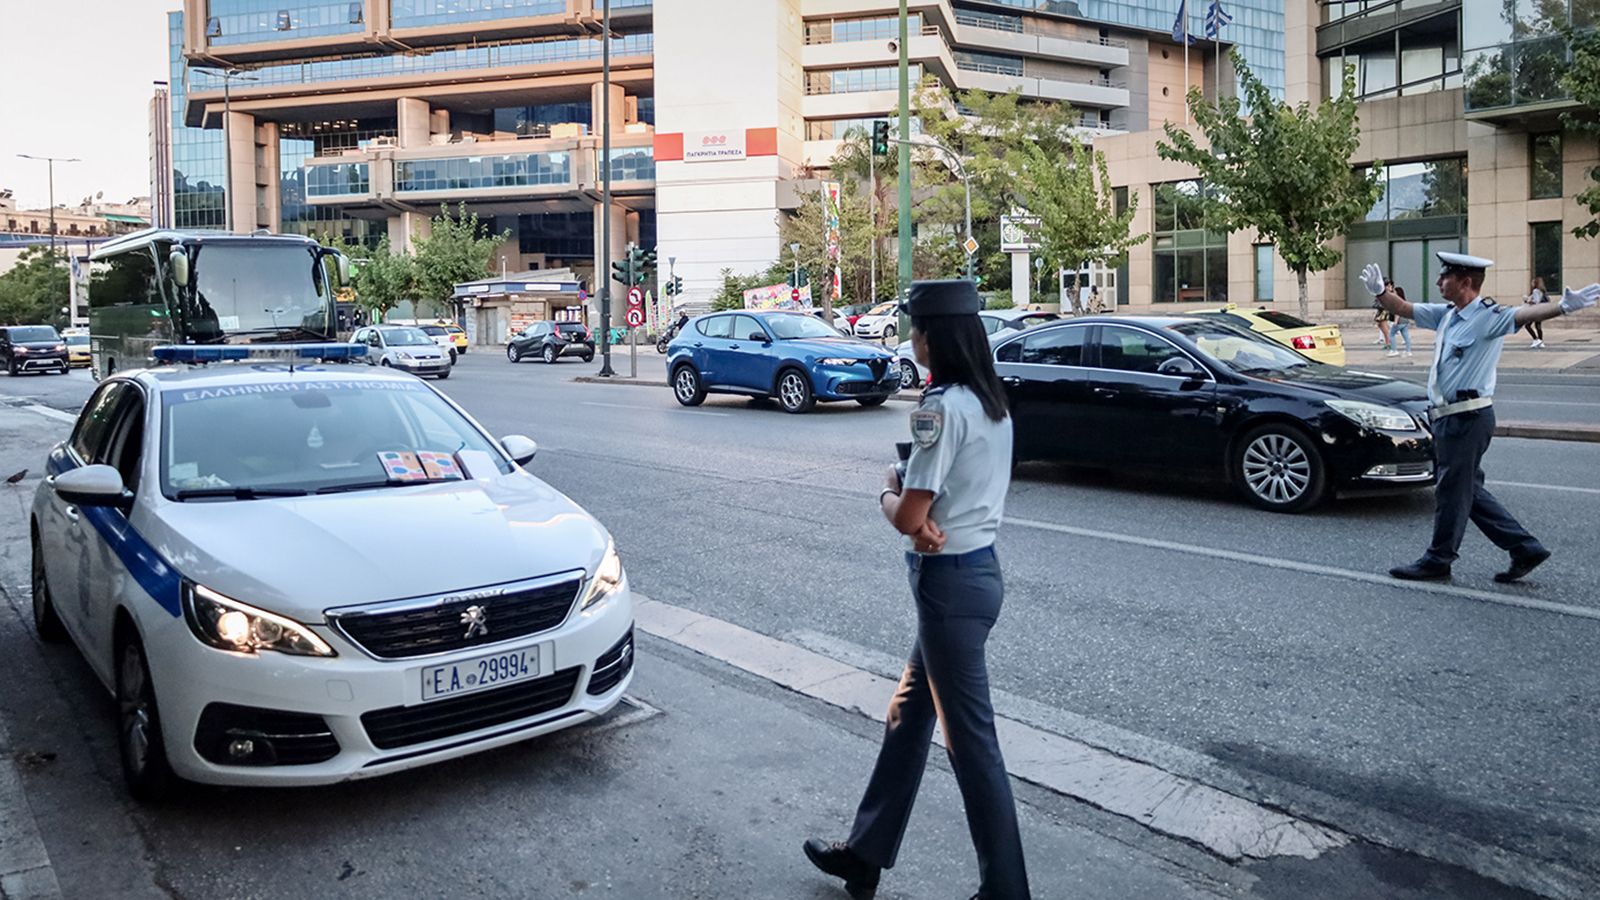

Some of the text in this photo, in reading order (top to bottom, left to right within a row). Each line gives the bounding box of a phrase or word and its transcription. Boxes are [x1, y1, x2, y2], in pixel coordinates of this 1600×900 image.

[183, 381, 419, 401] ΕΛΛΗΝΙΚΗ ΑΣΤΥΝΟΜΙΑ
[478, 652, 528, 685] 29994
